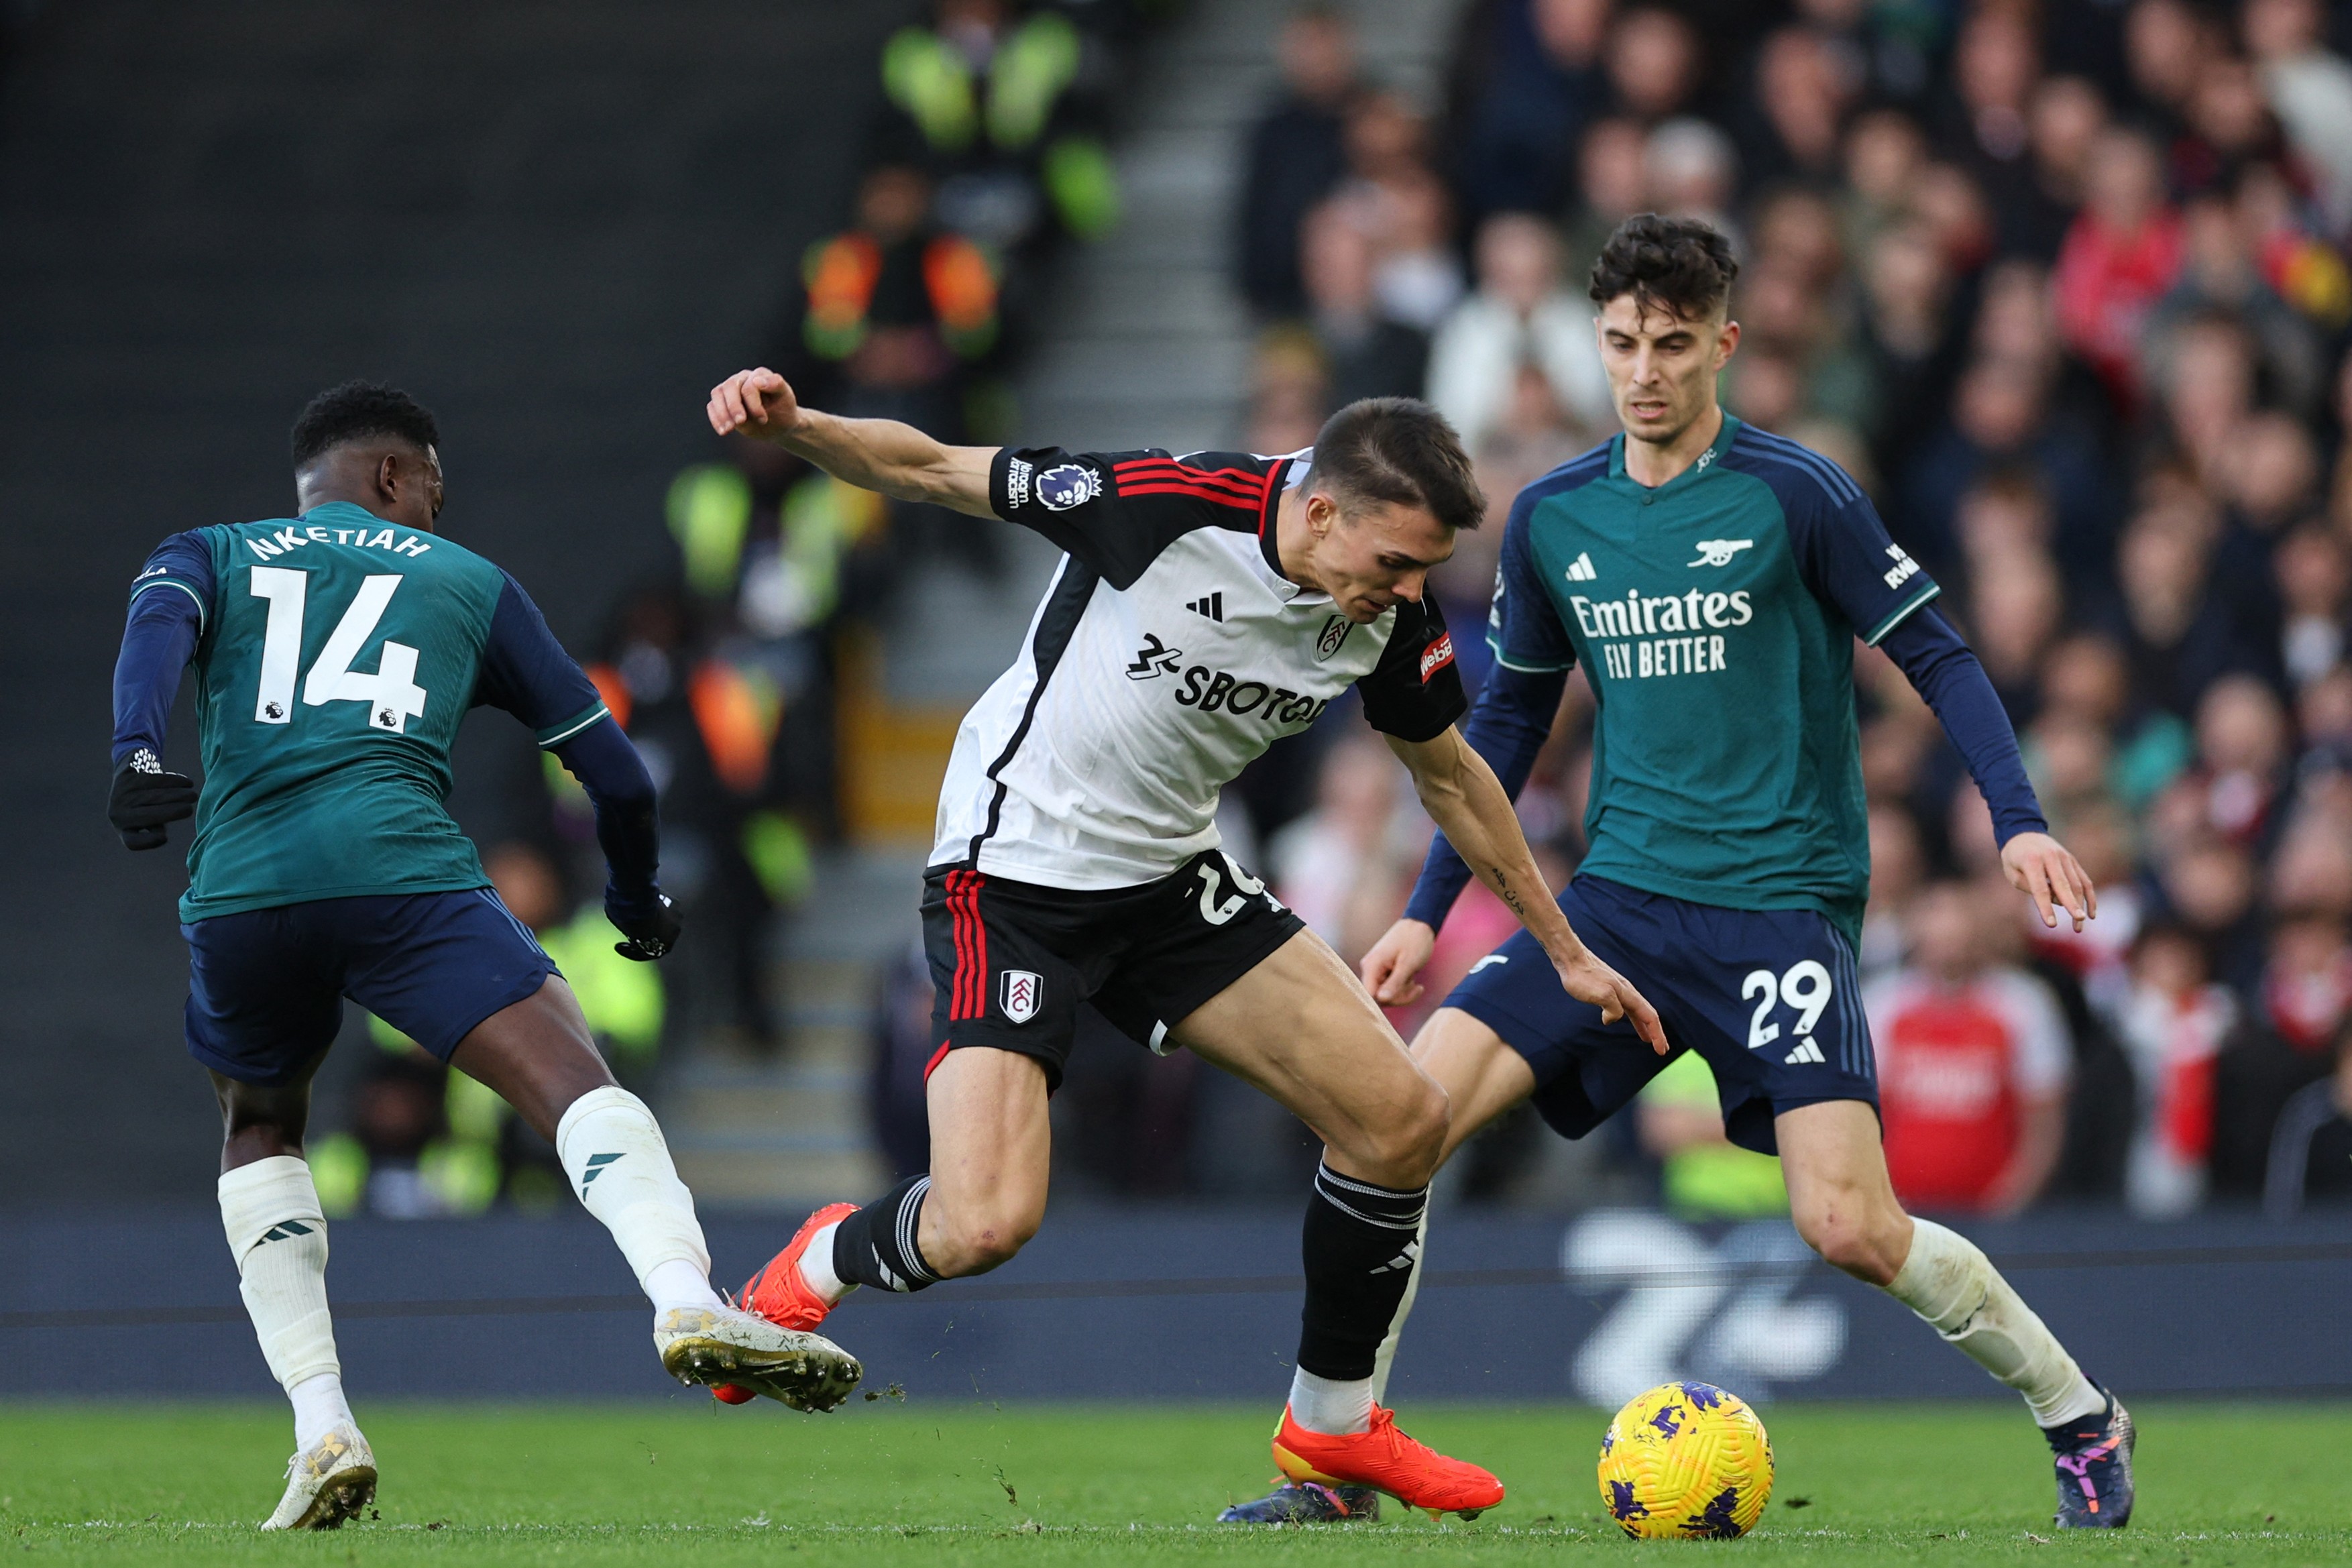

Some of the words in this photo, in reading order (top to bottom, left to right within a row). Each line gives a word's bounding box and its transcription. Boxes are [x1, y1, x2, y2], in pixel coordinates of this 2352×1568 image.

[1008, 470, 1019, 509] racism
[1017, 472, 1029, 504] room
[246, 526, 432, 562] NKETIAH
[1569, 587, 1752, 638] Emirates
[249, 565, 428, 734] 14
[1323, 621, 1346, 653] FFC
[1604, 642, 1632, 679] FLY
[1638, 634, 1727, 678] BETTER
[1011, 978, 1032, 1012] FFC
[1741, 959, 1833, 1050] 29
